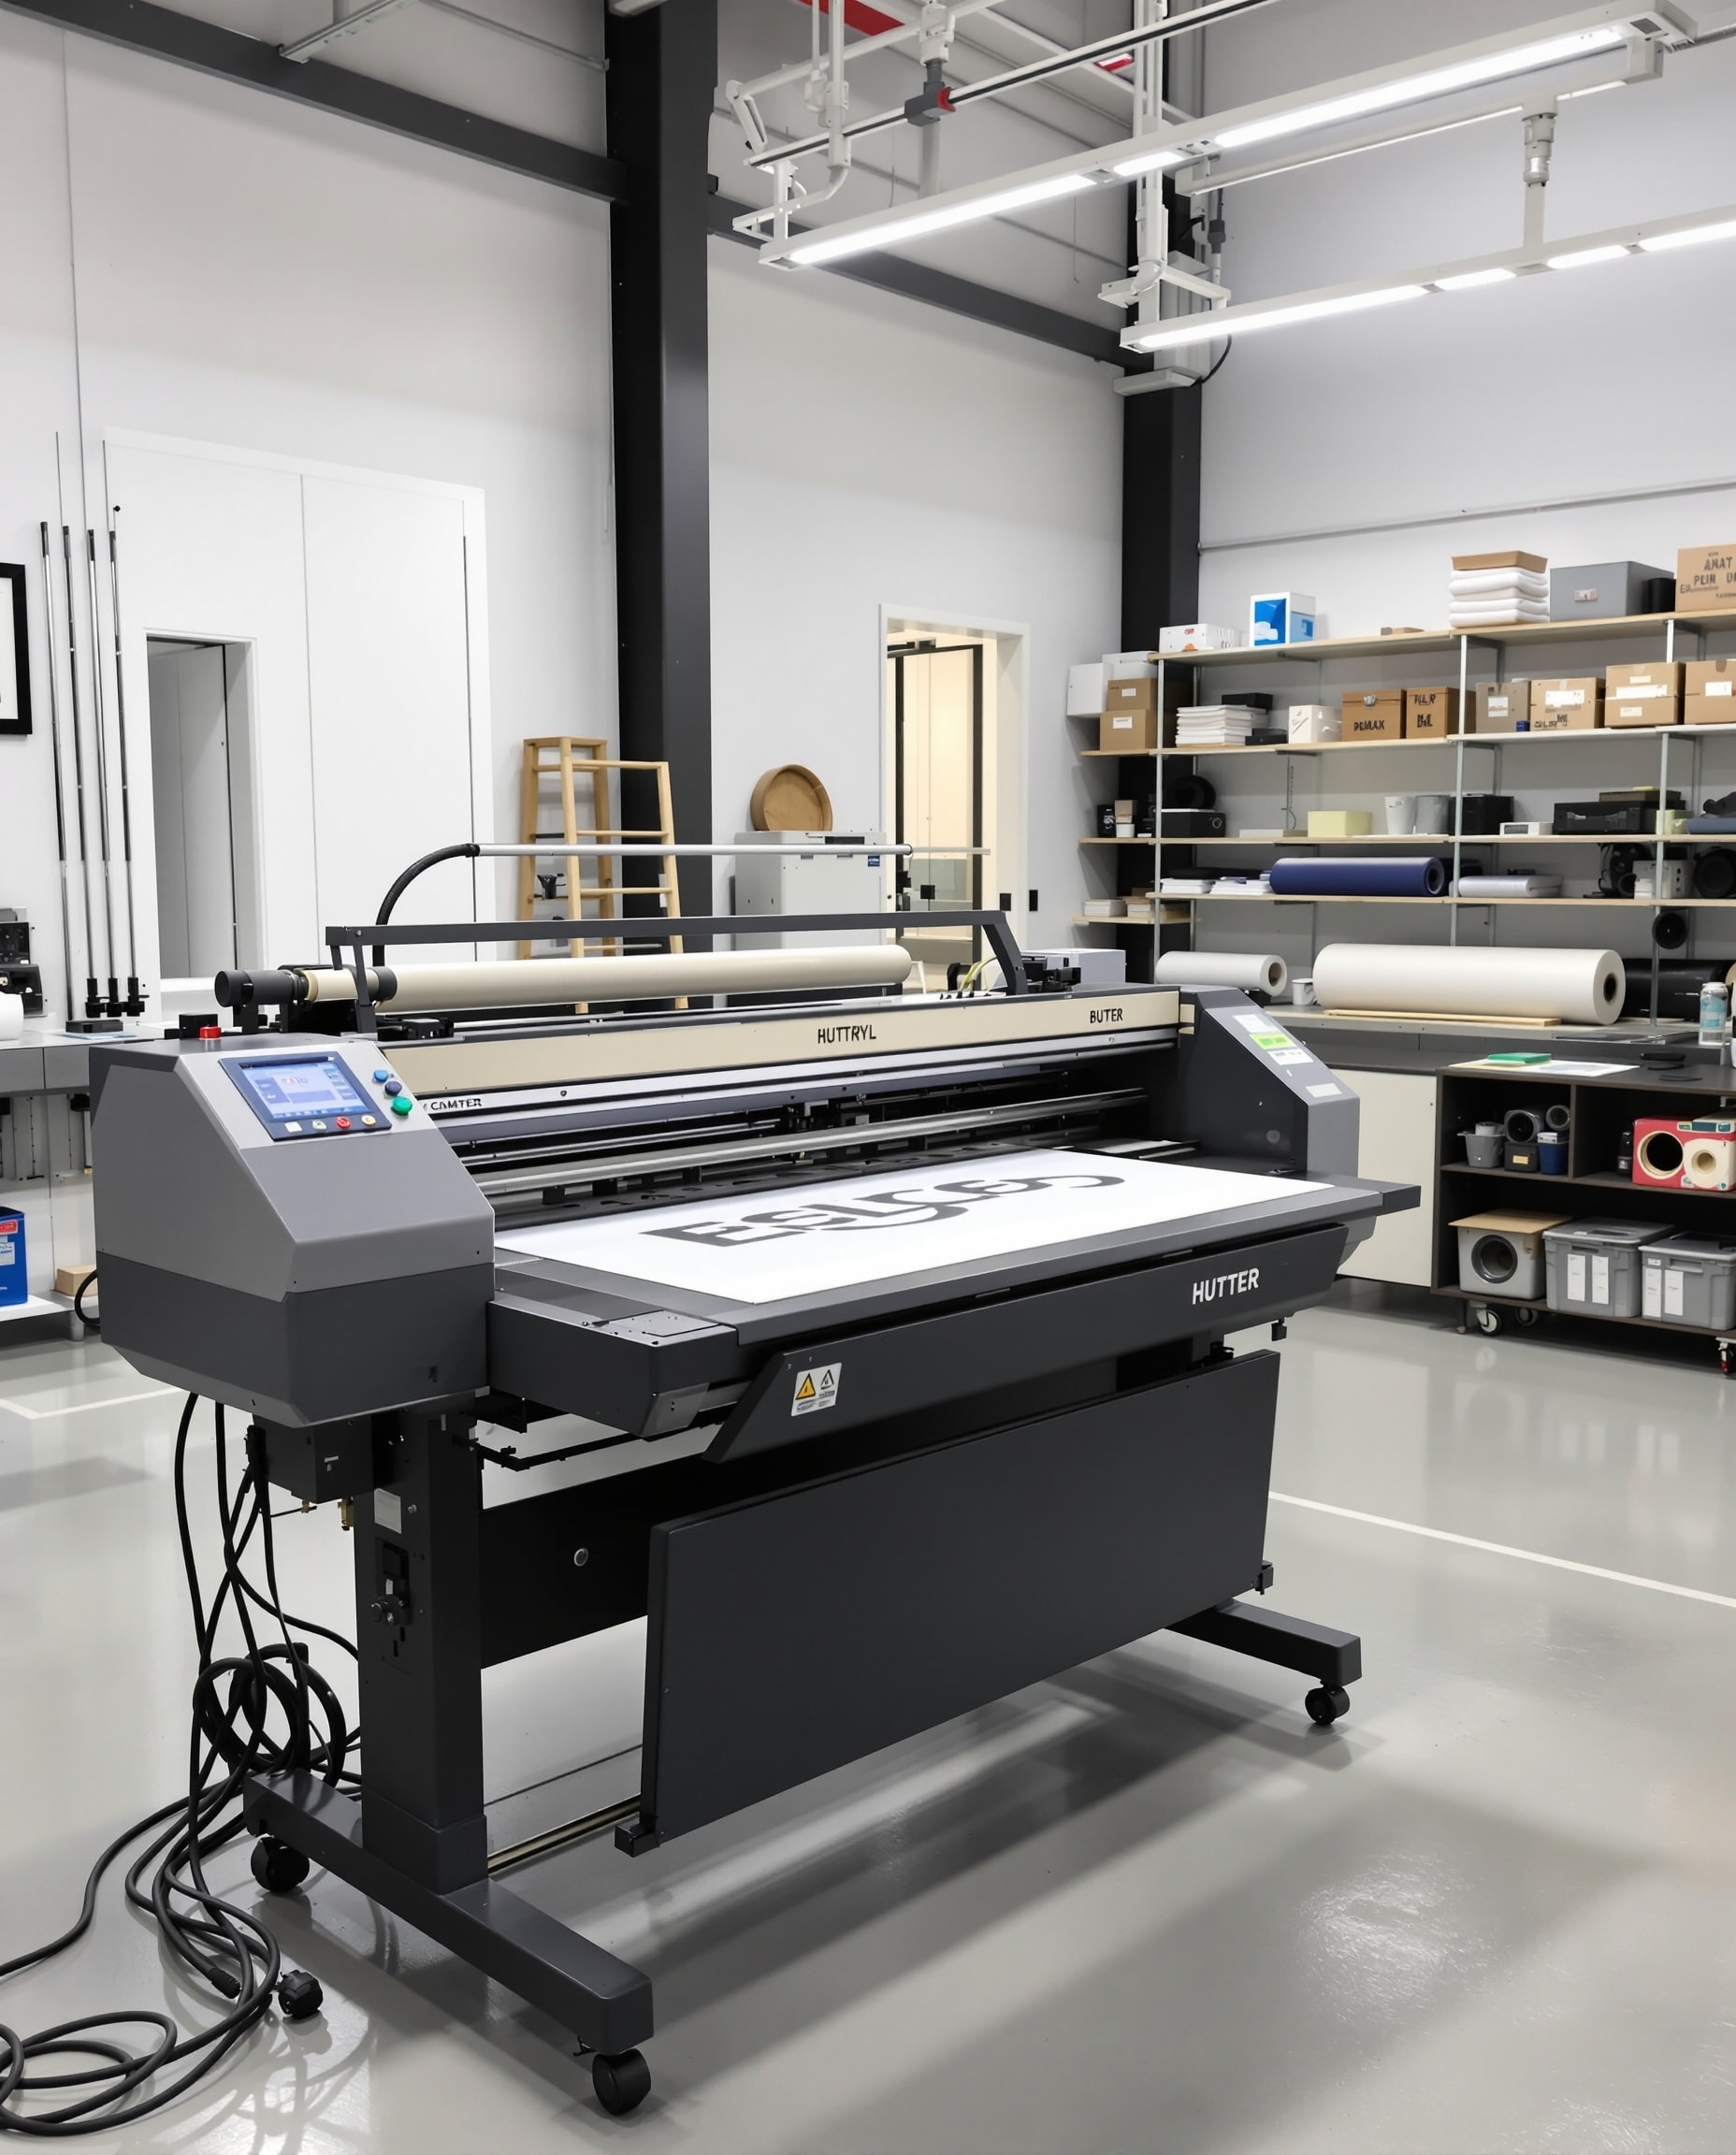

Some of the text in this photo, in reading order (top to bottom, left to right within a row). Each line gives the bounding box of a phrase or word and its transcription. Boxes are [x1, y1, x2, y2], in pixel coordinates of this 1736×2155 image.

[1090, 1008, 1123, 1024] BUTER
[817, 1024, 877, 1045] HUTTRYL
[1192, 1267, 1260, 1306] HUTTER
